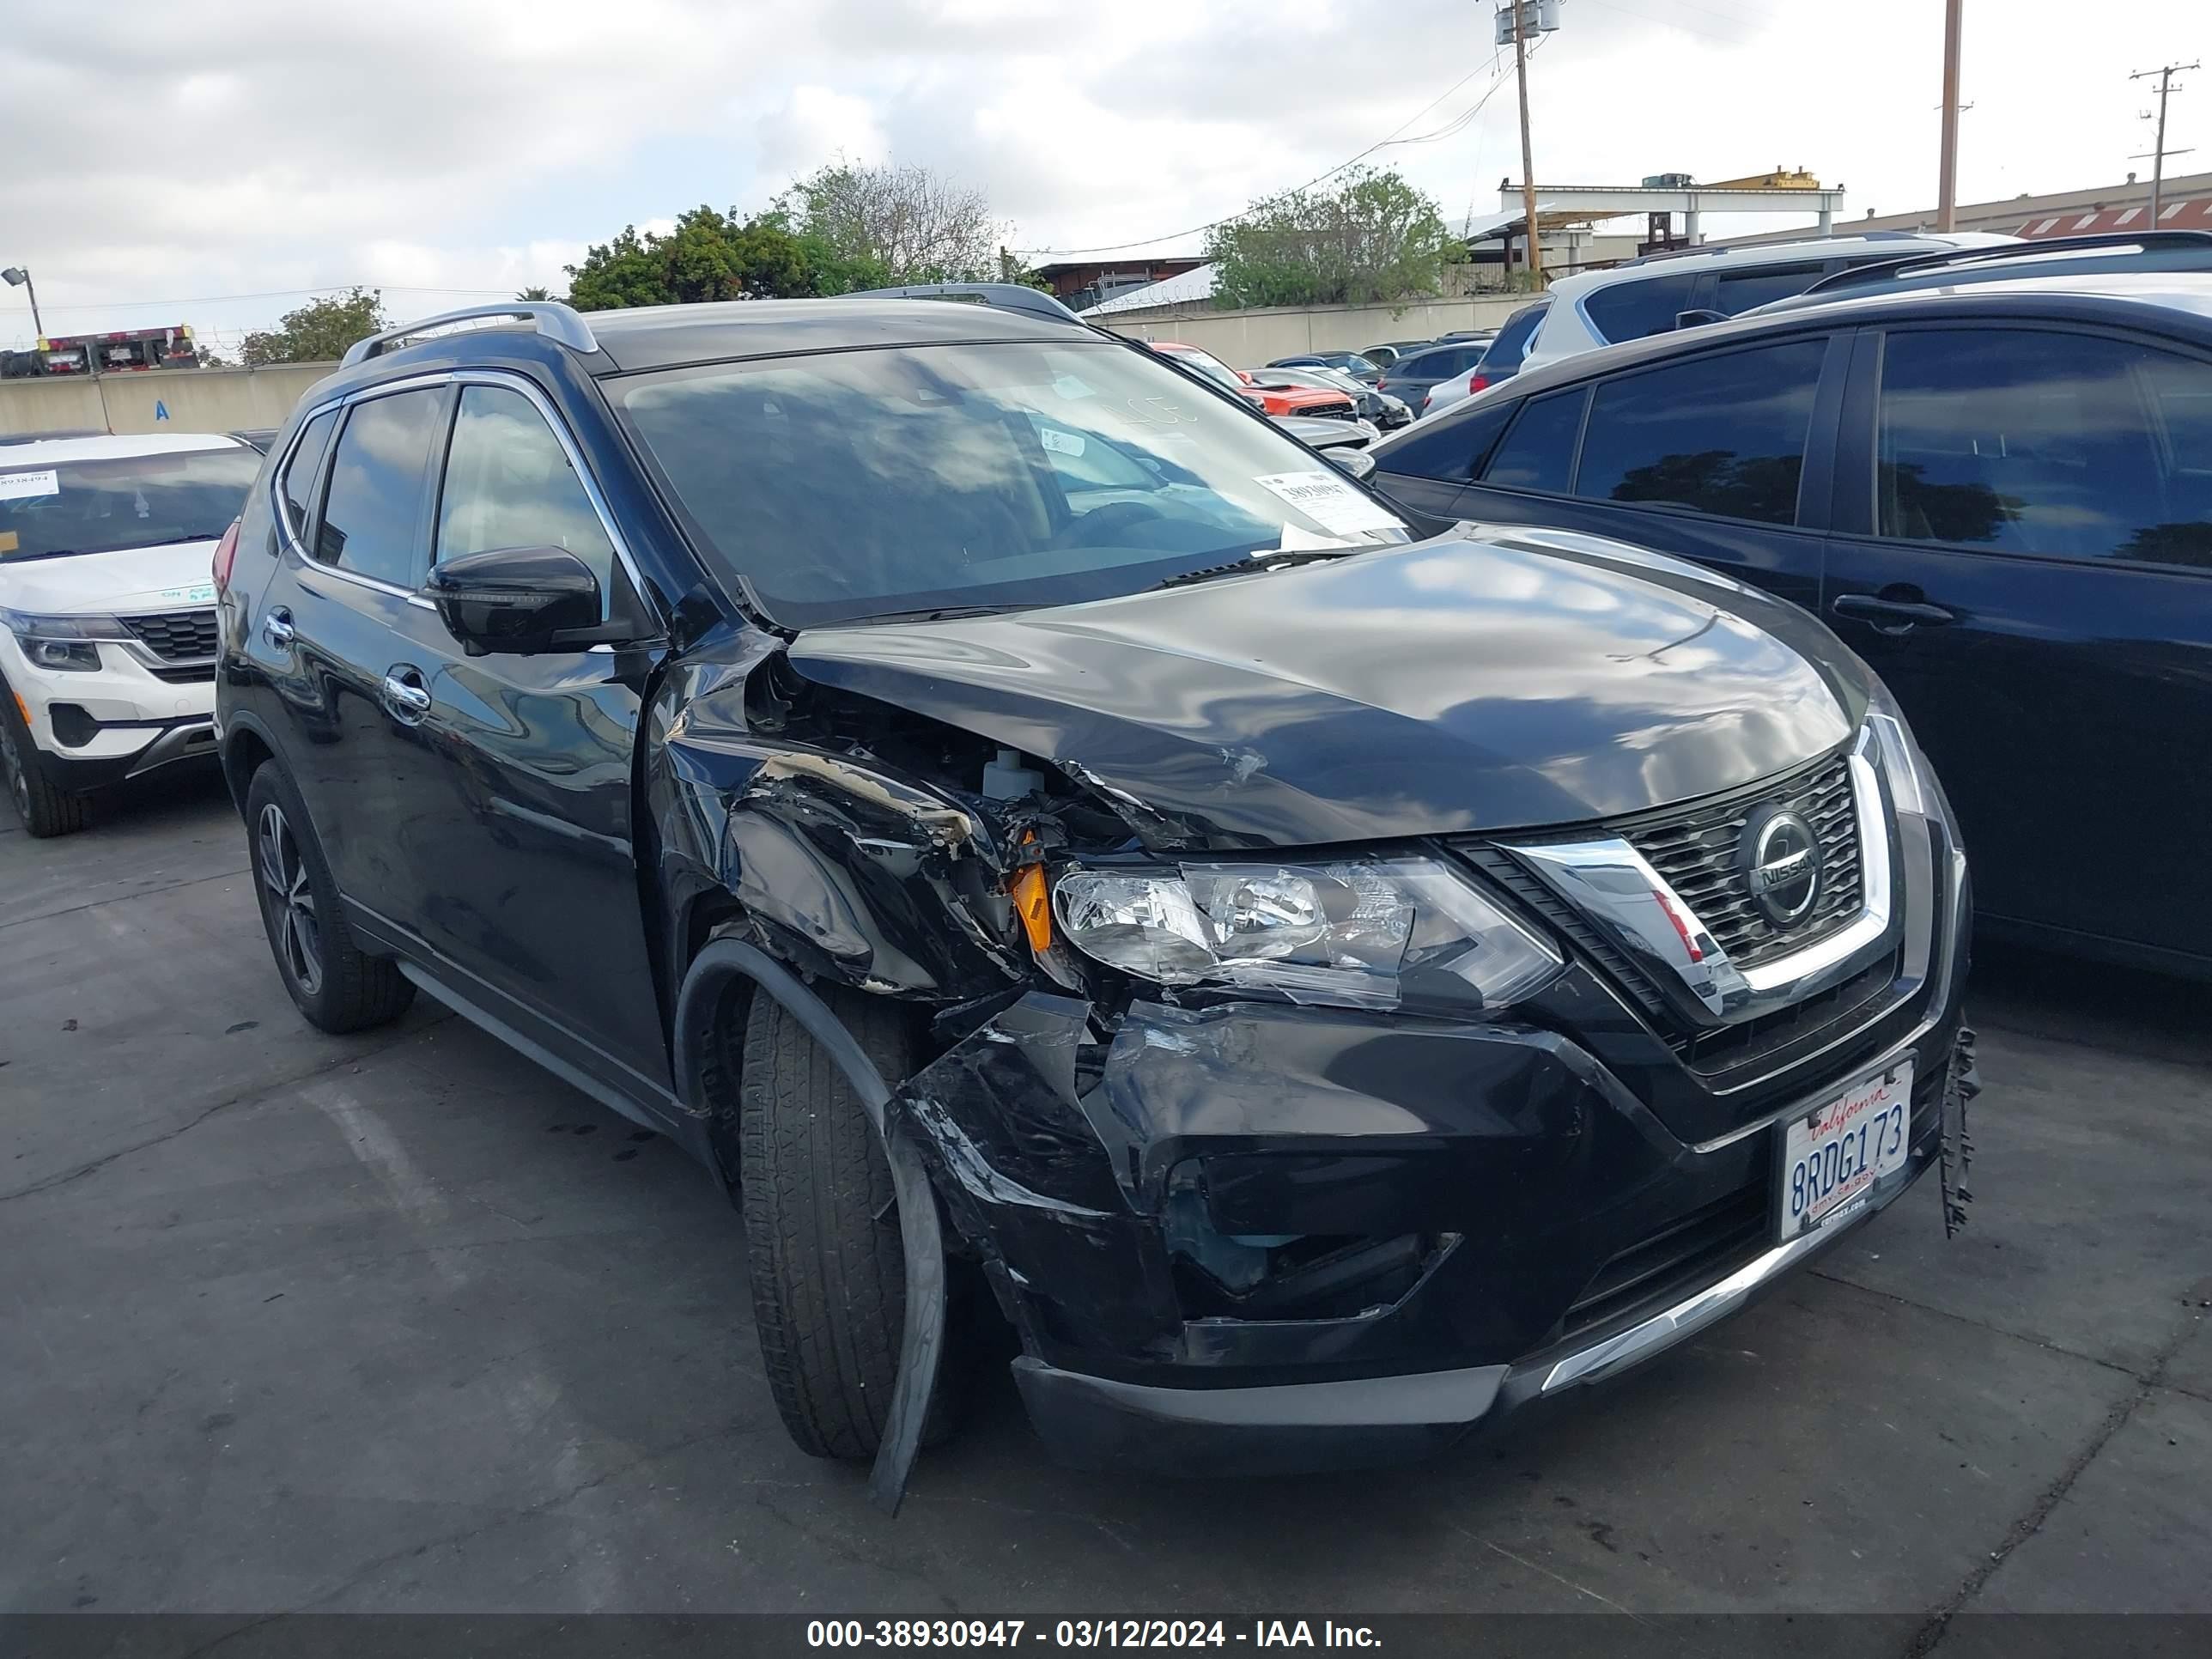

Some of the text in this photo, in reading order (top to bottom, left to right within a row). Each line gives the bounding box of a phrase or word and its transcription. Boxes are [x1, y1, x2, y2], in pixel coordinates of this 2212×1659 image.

[156, 399, 169, 420] A
[1762, 855, 1815, 886] NISSAN
[1810, 1085, 1893, 1141] California
[1792, 1103, 1903, 1217] 8RDG173
[1811, 1168, 1876, 1213] dmv.ca.gov
